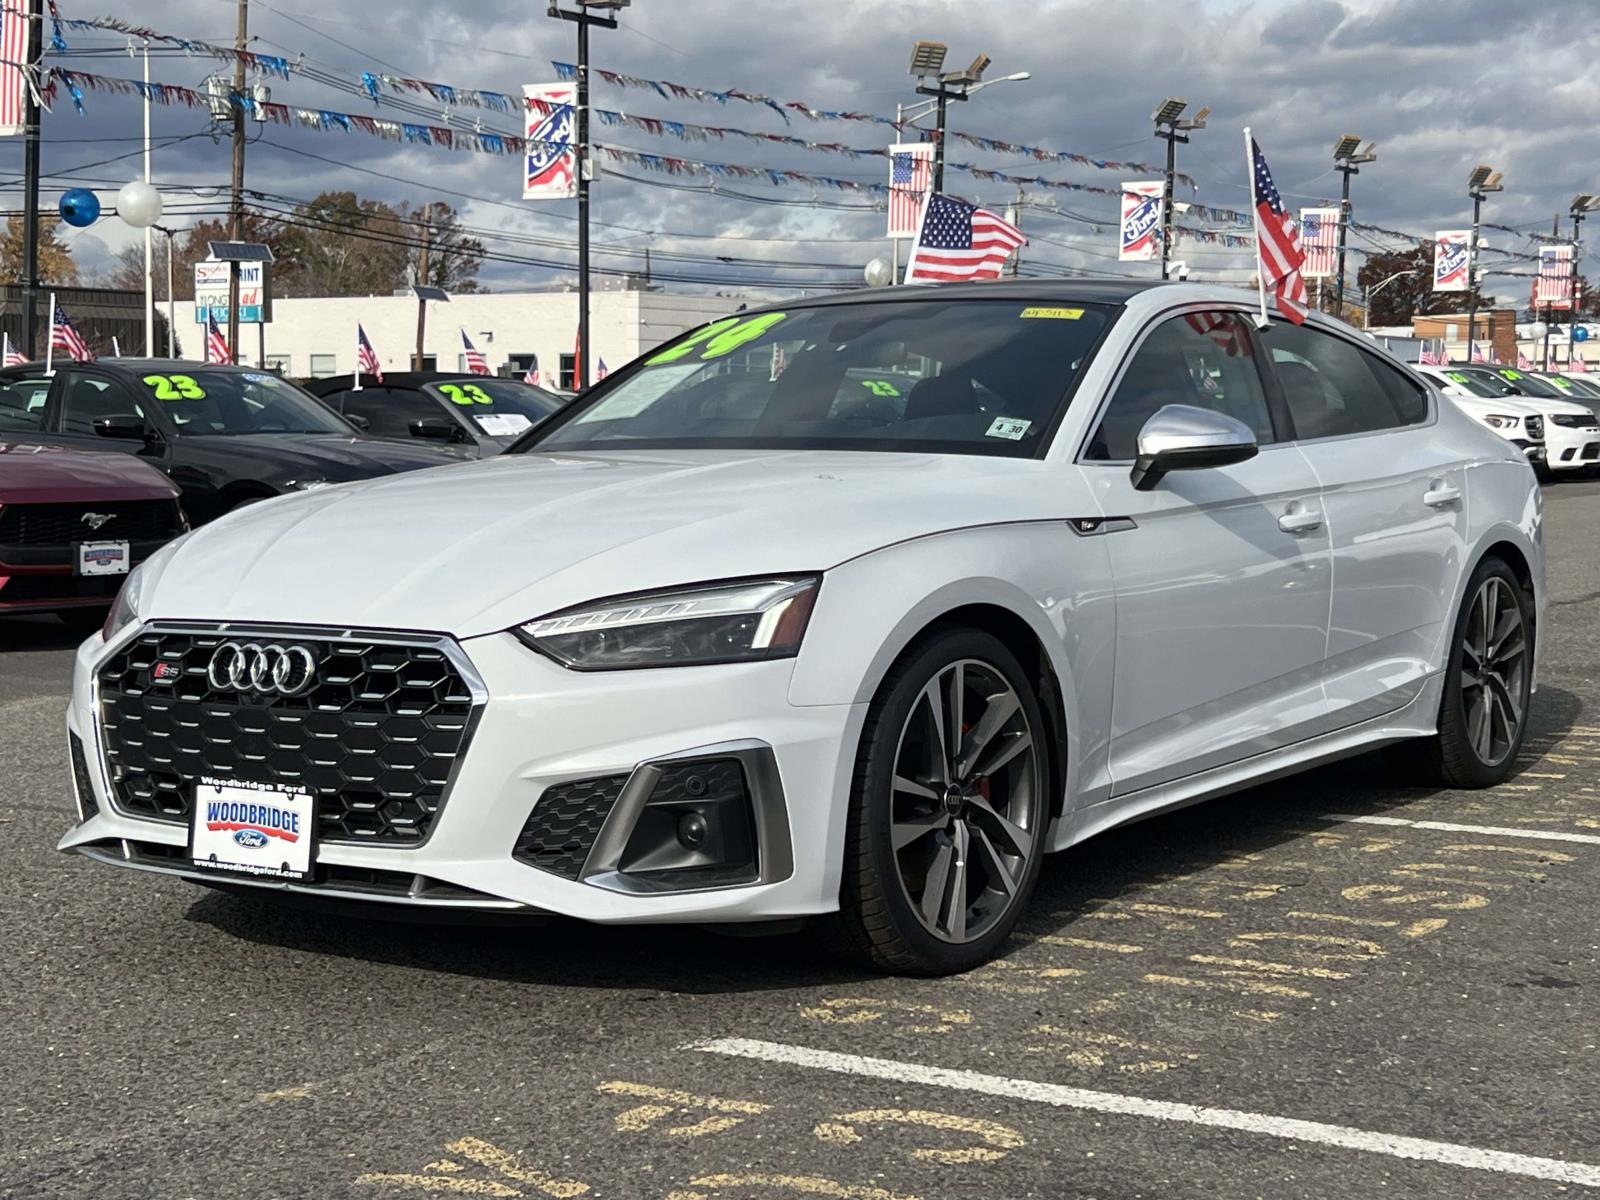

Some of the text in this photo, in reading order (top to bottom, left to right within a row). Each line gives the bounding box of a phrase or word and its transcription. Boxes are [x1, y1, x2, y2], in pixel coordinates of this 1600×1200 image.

[527, 111, 570, 168] Ford
[1124, 202, 1158, 240] Ford
[644, 312, 787, 366] 24
[143, 375, 206, 400] 23
[438, 384, 493, 405] 23
[862, 381, 900, 397] 23
[201, 776, 306, 794] Woodbridge Ford
[208, 801, 299, 834] WOODBRIDGE
[240, 831, 263, 847] Ford
[194, 860, 303, 879] www.woodbridgeford.com
